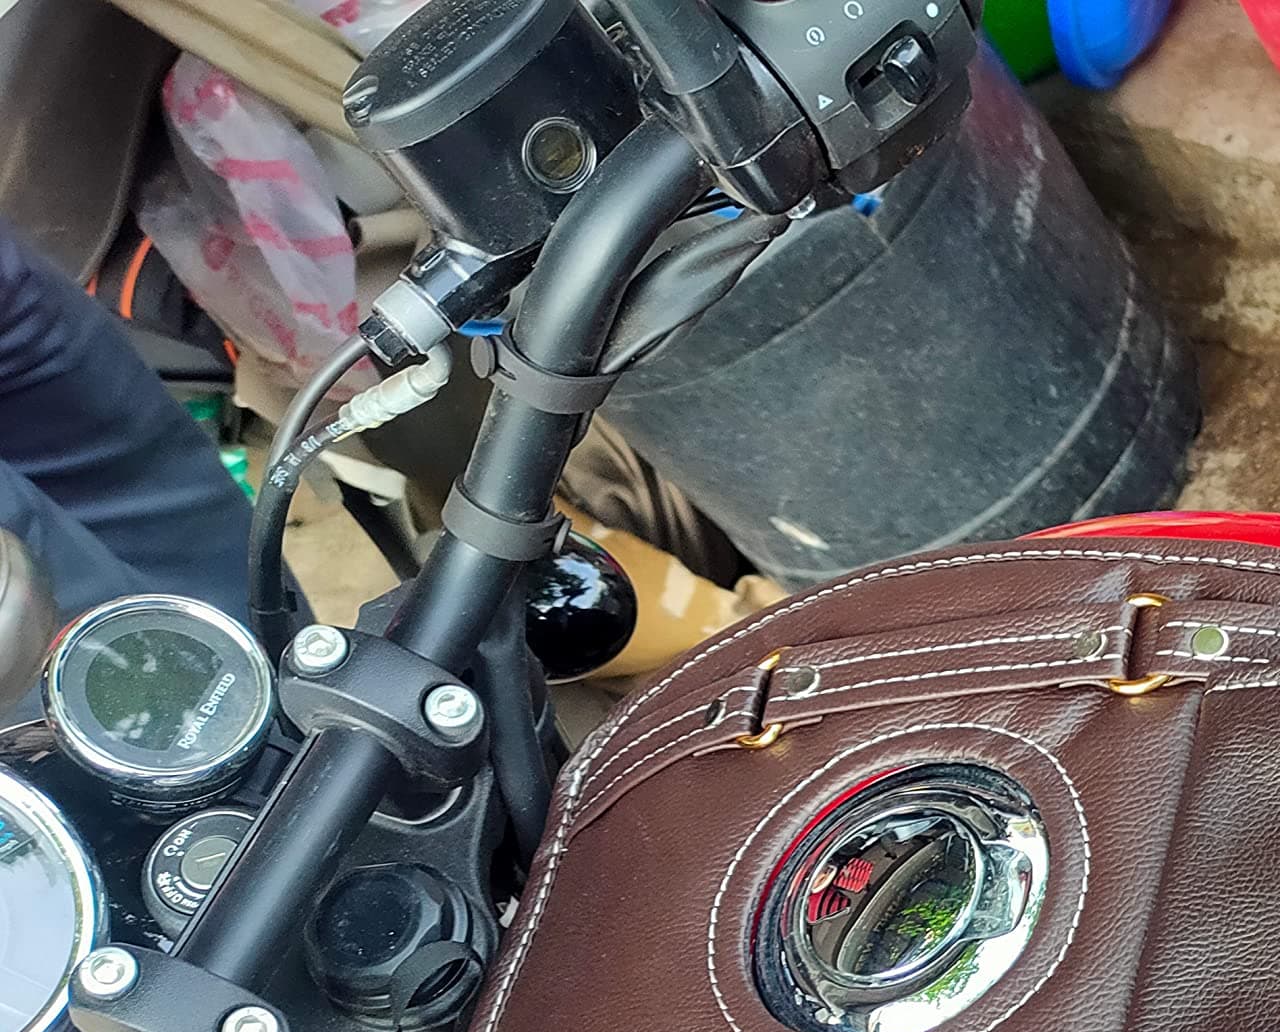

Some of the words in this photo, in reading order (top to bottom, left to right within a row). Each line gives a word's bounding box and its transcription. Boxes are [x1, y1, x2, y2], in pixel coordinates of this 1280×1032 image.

[177, 715, 210, 750] ROYAL
[199, 672, 236, 716] ENFIELD
[172, 828, 194, 846] ON
